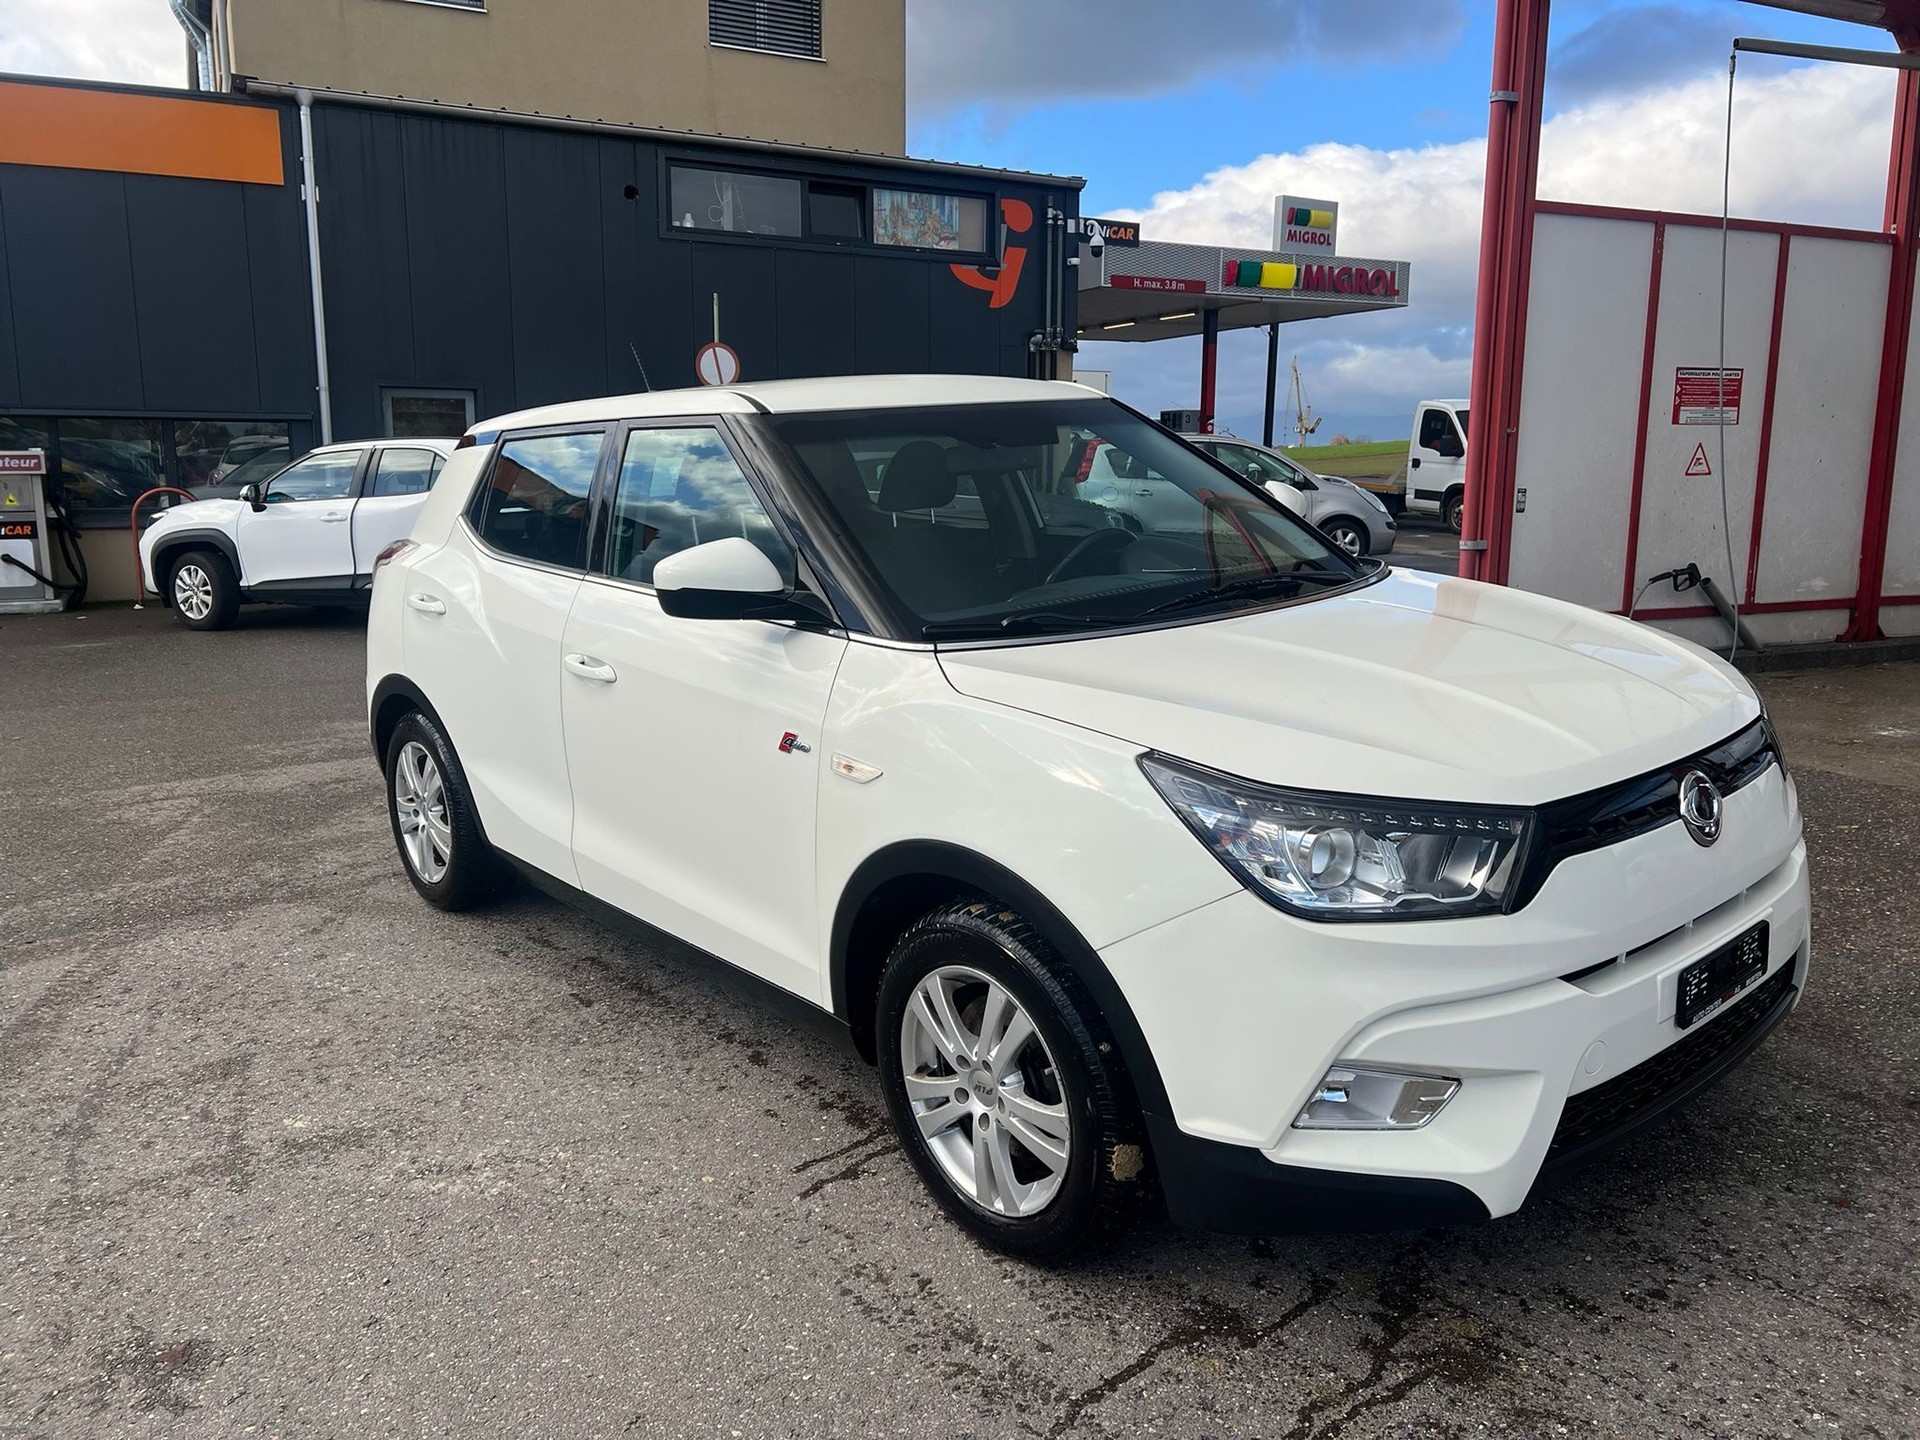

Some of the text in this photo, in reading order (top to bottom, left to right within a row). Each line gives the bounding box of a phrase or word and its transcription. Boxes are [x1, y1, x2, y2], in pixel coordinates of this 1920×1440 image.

[1286, 228, 1332, 246] MIGROL
[1133, 277, 1142, 288] H.
[1143, 279, 1163, 289] max.
[1301, 263, 1400, 297] MIGROL
[1185, 414, 1191, 424] 3
